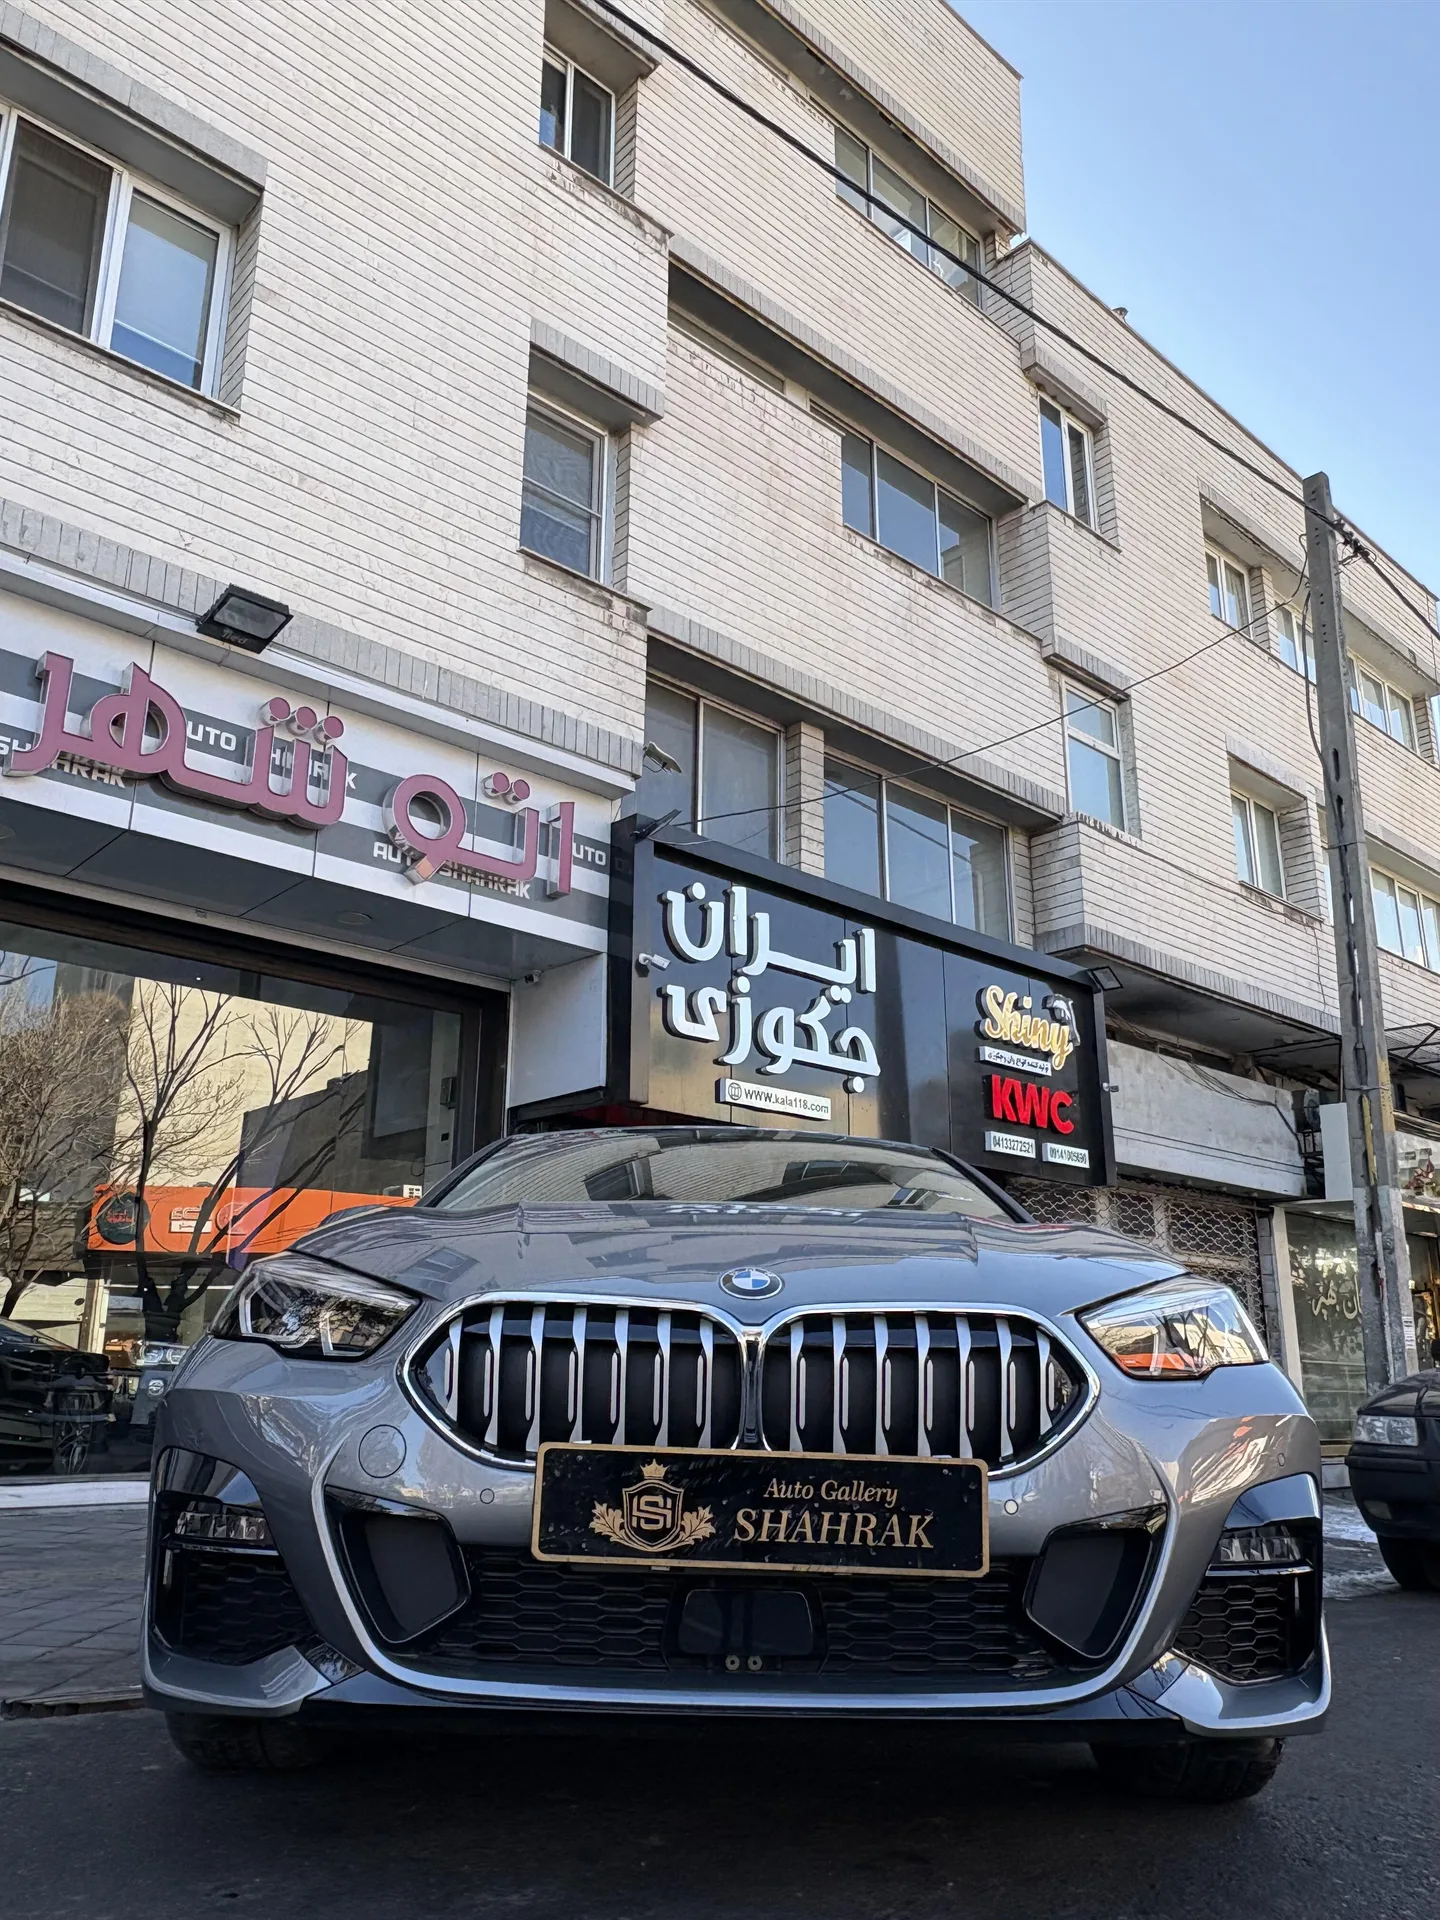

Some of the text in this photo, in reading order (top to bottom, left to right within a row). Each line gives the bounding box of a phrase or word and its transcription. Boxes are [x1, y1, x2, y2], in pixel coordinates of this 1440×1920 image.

[187, 720, 237, 751] UTO
[382, 771, 575, 898] اتو
[573, 842, 606, 866] UTO
[660, 882, 877, 1004] ایران
[660, 976, 881, 1093] جکوزی
[984, 984, 1073, 1070] Shiny
[990, 1074, 1075, 1134] KWC
[764, 1478, 898, 1509] Auto Gallery
[734, 1508, 934, 1548] SHAHRAK
